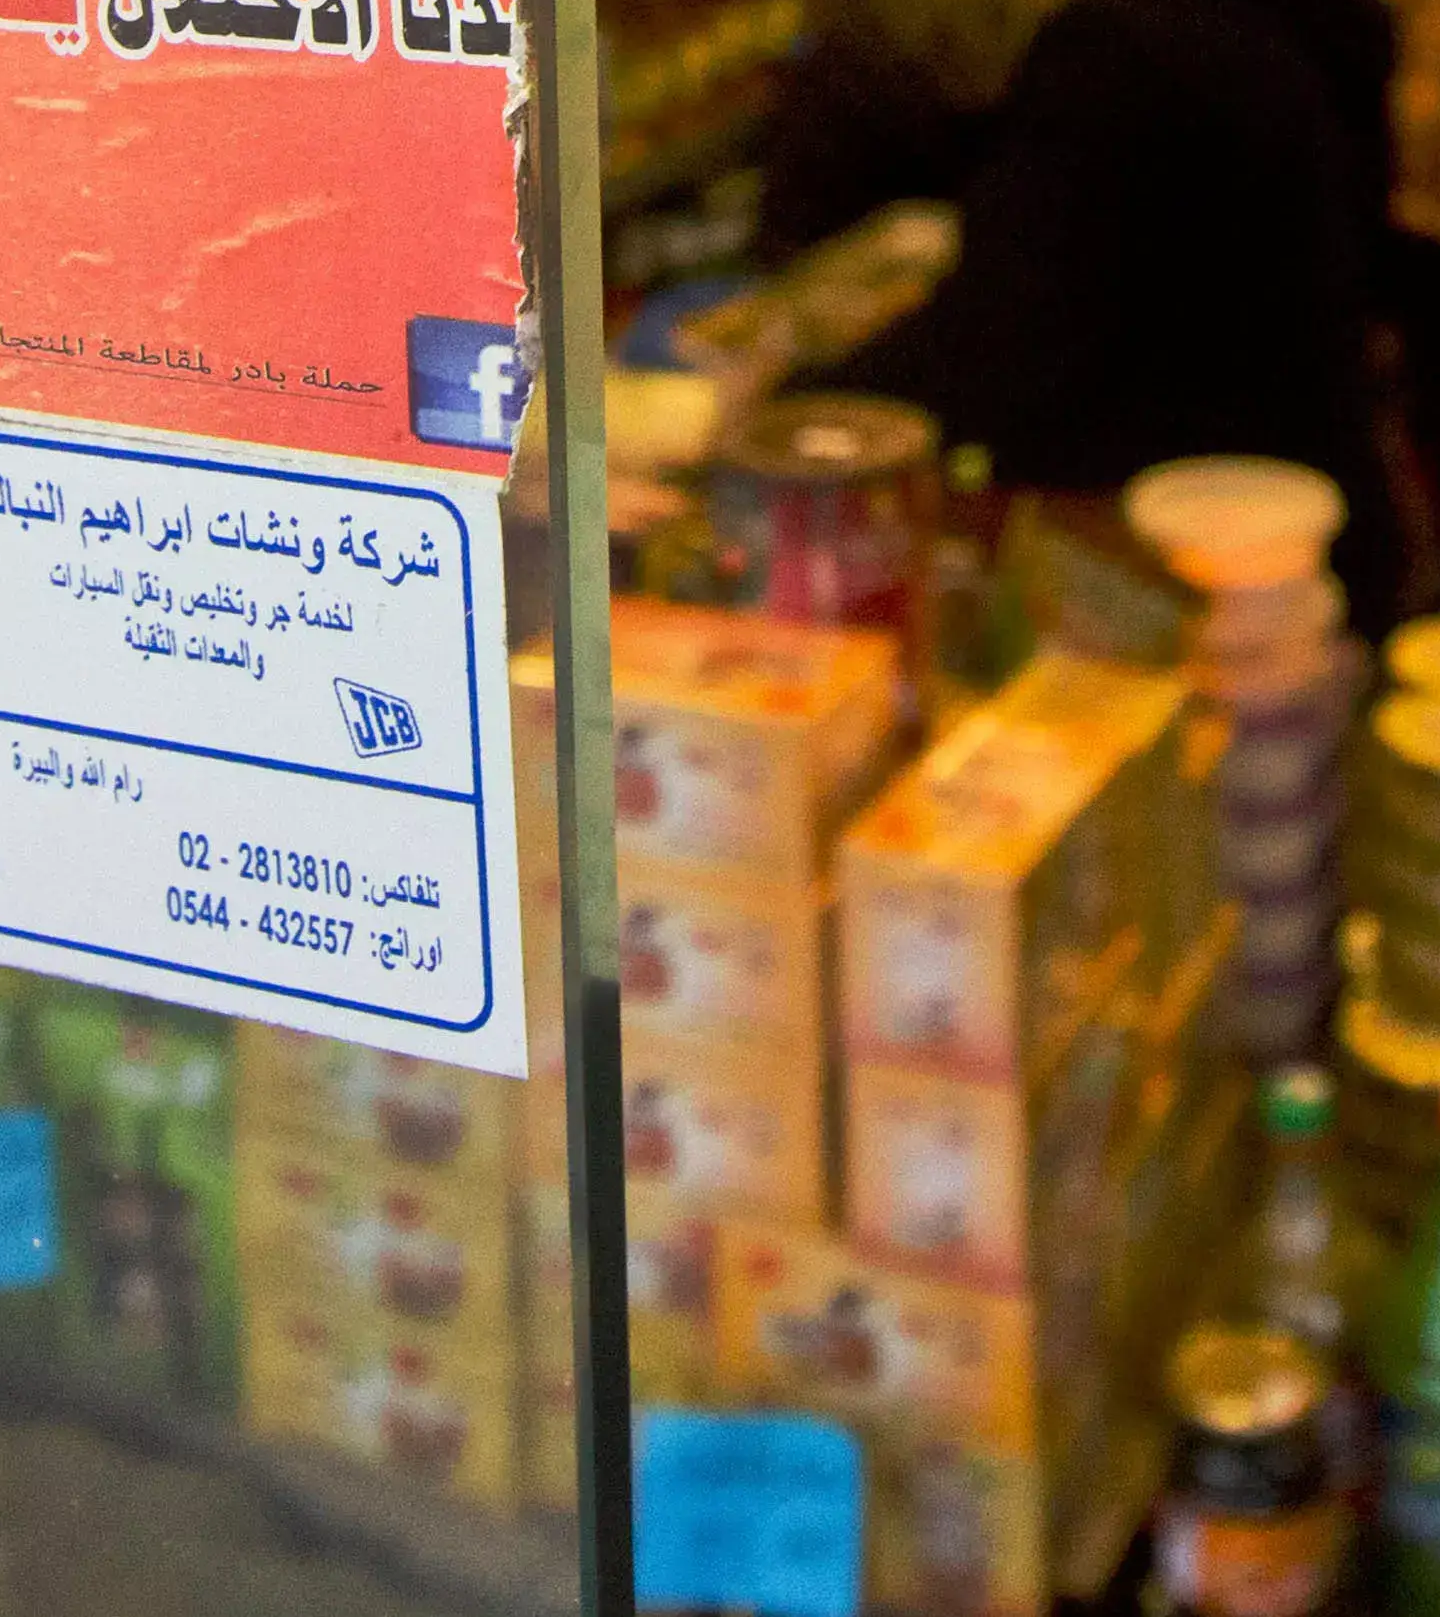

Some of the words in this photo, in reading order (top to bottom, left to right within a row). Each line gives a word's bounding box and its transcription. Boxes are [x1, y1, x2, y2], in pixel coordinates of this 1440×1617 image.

[99, 337, 213, 376] لمقاطعة
[231, 361, 287, 392] بادر
[301, 365, 385, 395] حملة
[78, 497, 192, 550] ابراهيم
[207, 509, 326, 574] ونشات
[339, 515, 439, 586] شركة
[49, 564, 124, 600] السيارات
[131, 571, 173, 615] ونقل
[181, 585, 259, 627] وتخليص
[266, 602, 292, 631] جر
[298, 591, 353, 632] لخدمة
[123, 615, 177, 661] الثقيلة
[184, 638, 266, 680] والمعدات
[348, 687, 415, 750] JCB
[11, 741, 74, 789] والبيرة
[81, 755, 105, 787] الله
[114, 763, 143, 803] رام
[178, 831, 210, 871] 02
[238, 842, 352, 899] 2813810
[166, 885, 230, 932] 0544
[361, 874, 440, 909] تلفاكس:
[258, 904, 354, 956] 432557
[369, 926, 443, 972] اورانج:
